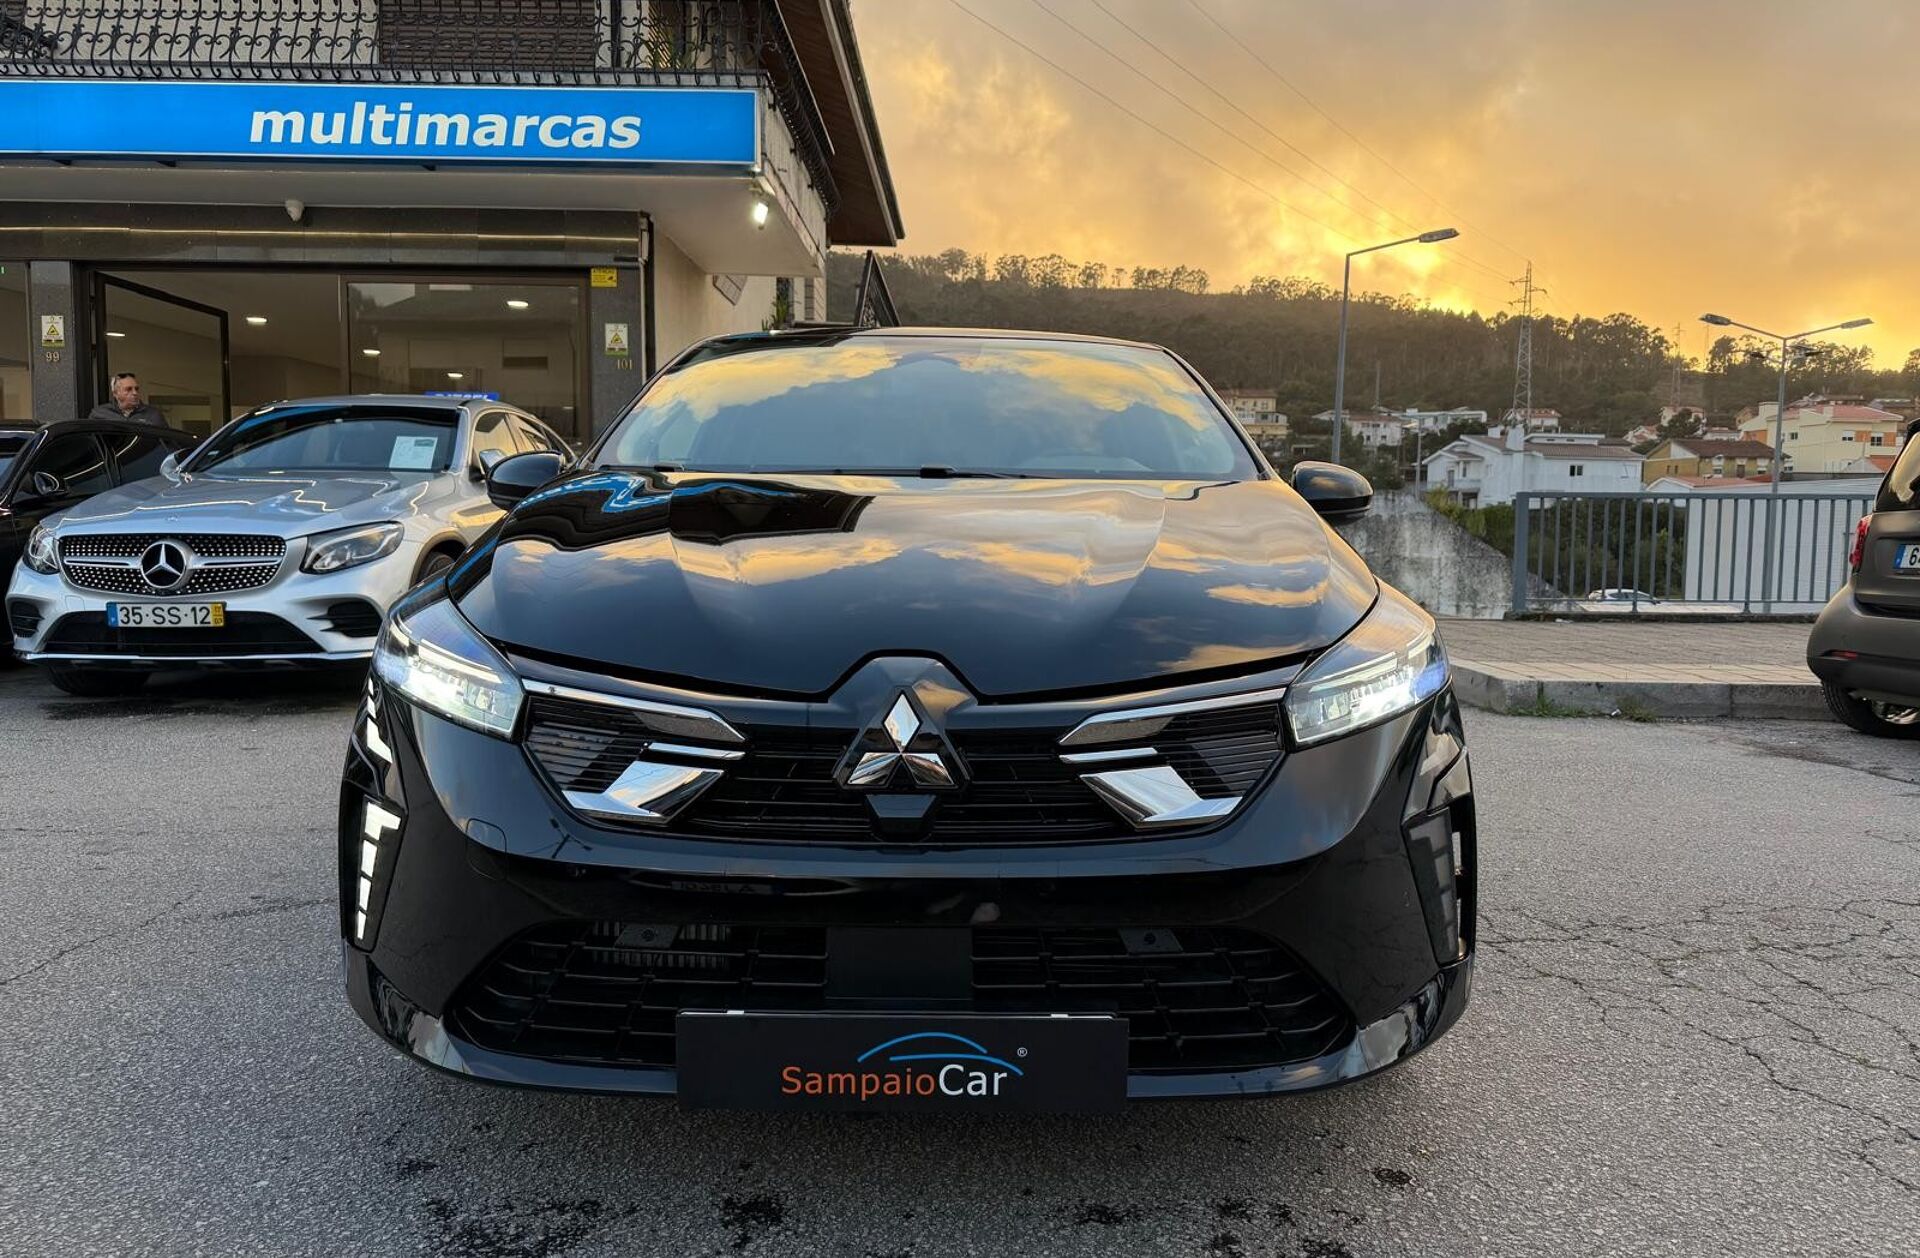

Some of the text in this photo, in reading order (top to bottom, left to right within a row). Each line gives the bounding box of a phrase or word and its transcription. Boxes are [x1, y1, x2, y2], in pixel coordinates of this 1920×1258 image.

[250, 102, 641, 148] multimarcas
[46, 351, 60, 362] 99
[617, 360, 632, 370] 101
[1909, 547, 1920, 566] 6
[782, 1063, 1007, 1100] SampaioCar
